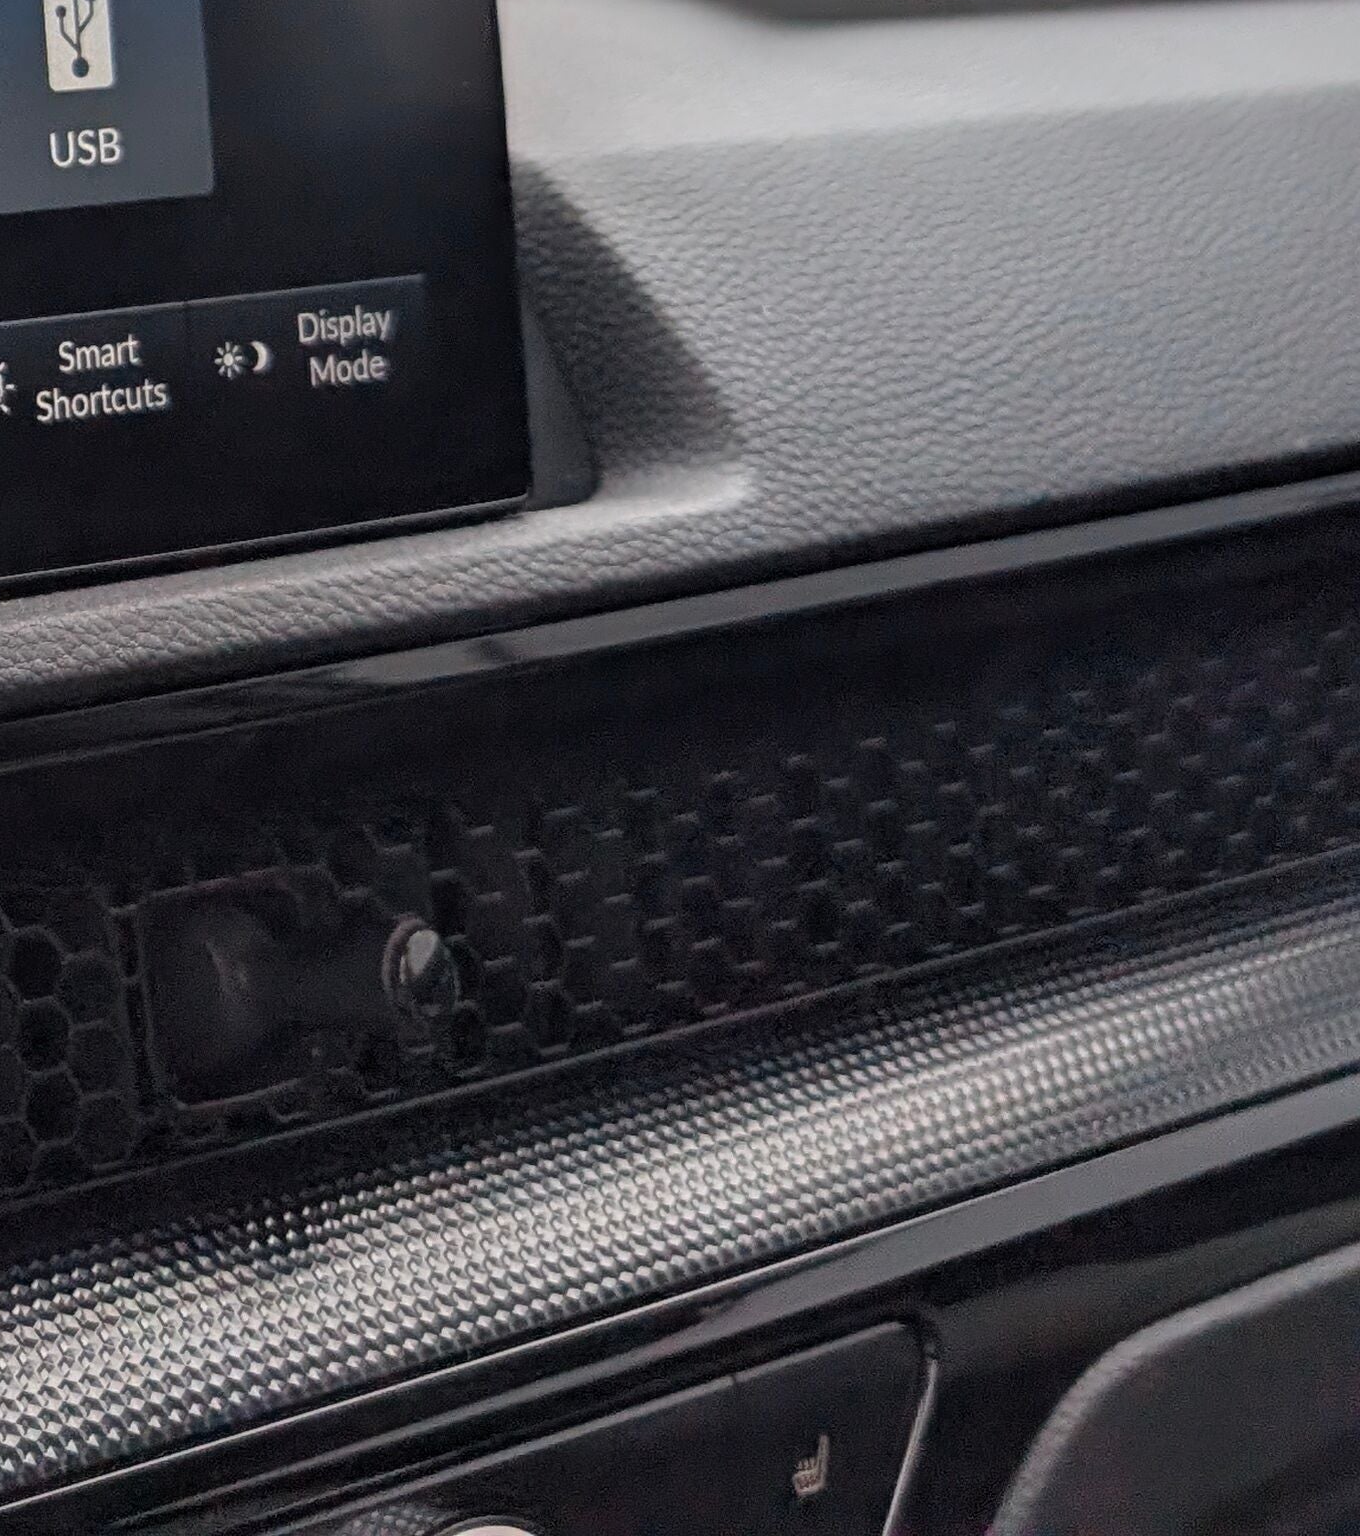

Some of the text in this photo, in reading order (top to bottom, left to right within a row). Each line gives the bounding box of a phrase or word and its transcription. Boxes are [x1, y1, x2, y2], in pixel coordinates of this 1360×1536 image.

[49, 127, 121, 168] USB
[297, 304, 391, 346] Display
[58, 334, 140, 373] Smart
[309, 348, 388, 387] Mode
[36, 378, 169, 423] Shortcuts
